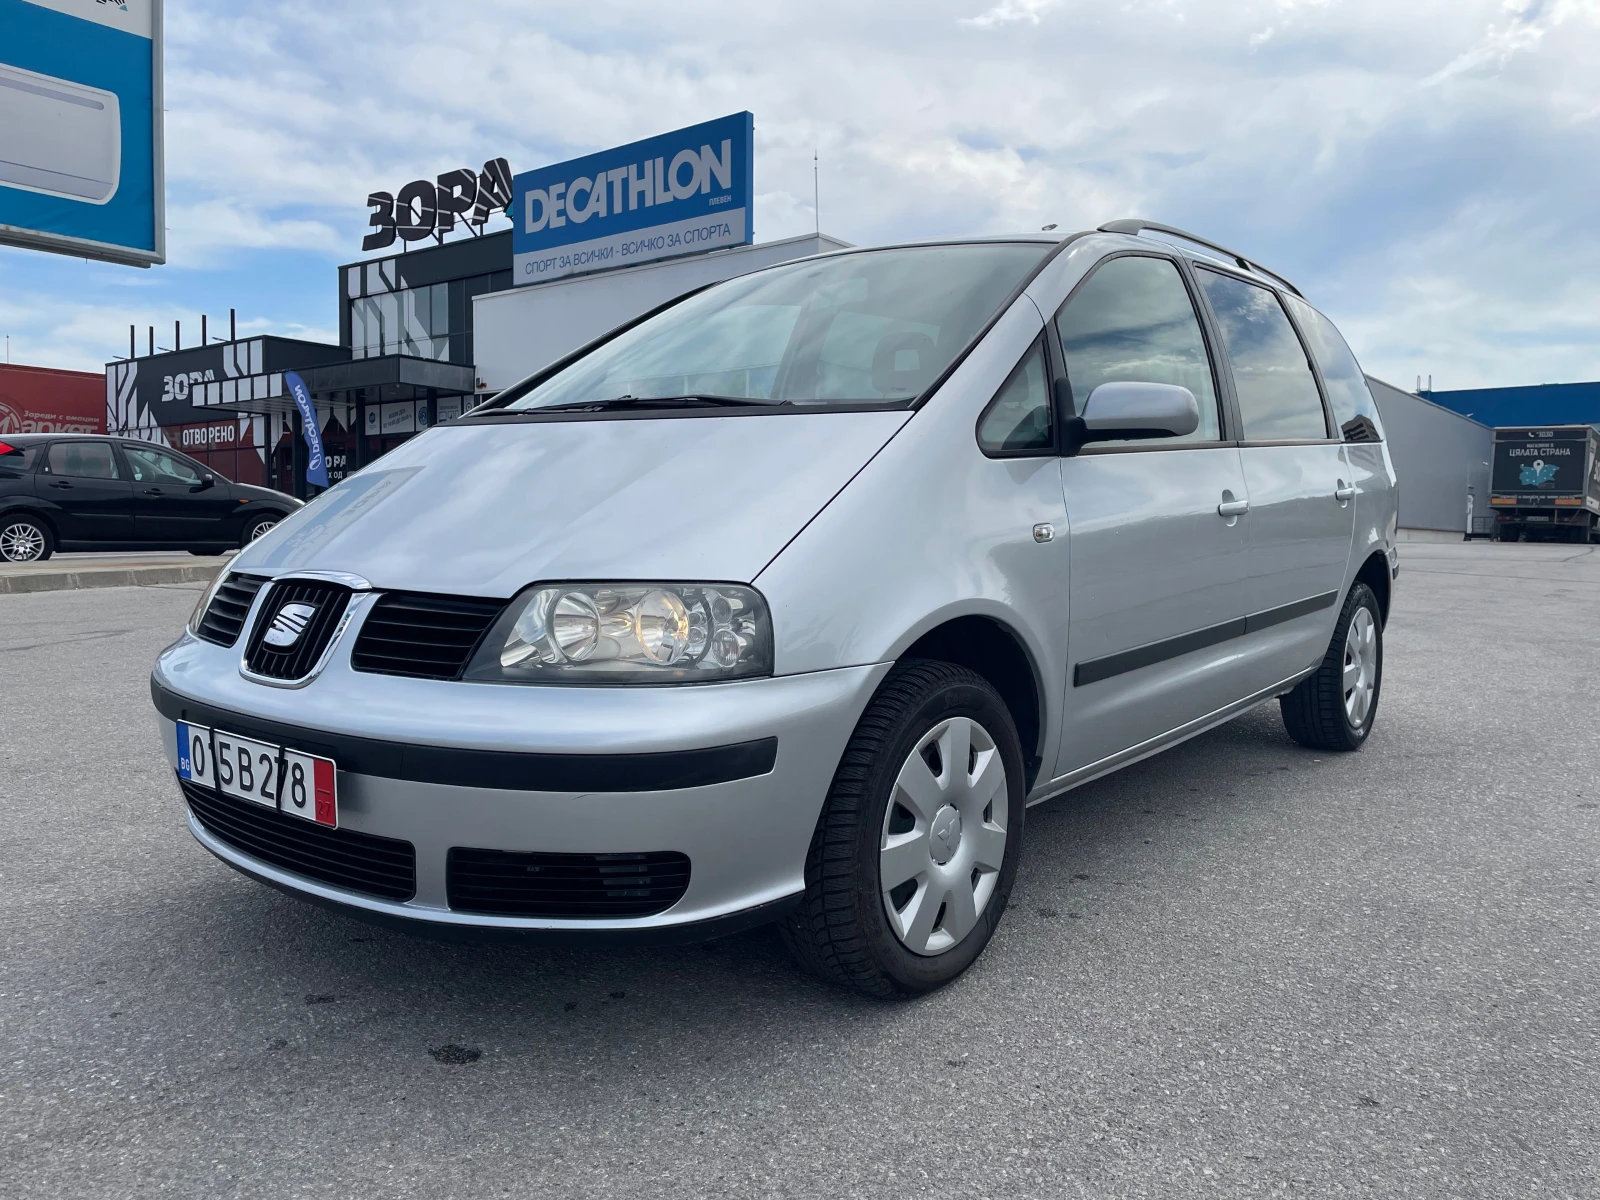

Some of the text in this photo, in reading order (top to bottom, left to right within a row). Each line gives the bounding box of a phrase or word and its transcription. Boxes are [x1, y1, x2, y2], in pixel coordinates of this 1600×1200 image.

[525, 139, 731, 234] DECATHLON
[362, 157, 513, 251] ЗОРА
[709, 195, 731, 206] ПЛЕВЕН
[525, 257, 557, 275] СПОРТ
[559, 255, 571, 268] ЗА
[573, 246, 613, 266] ВСИЧКИ
[621, 236, 664, 256] ВСИЧКО
[667, 233, 681, 247] ЗА
[684, 223, 731, 244] СПОРТА
[24, 410, 56, 420] Зареди
[66, 415, 100, 423] емоции
[294, 384, 320, 454] DECATHLON
[182, 425, 235, 446] ОТВОРЕНО
[325, 455, 346, 468] ОРА
[1509, 448, 1570, 457] ЦЯЛАТА СТРАНА
[180, 757, 190, 771] BG
[192, 734, 307, 809] 05B278
